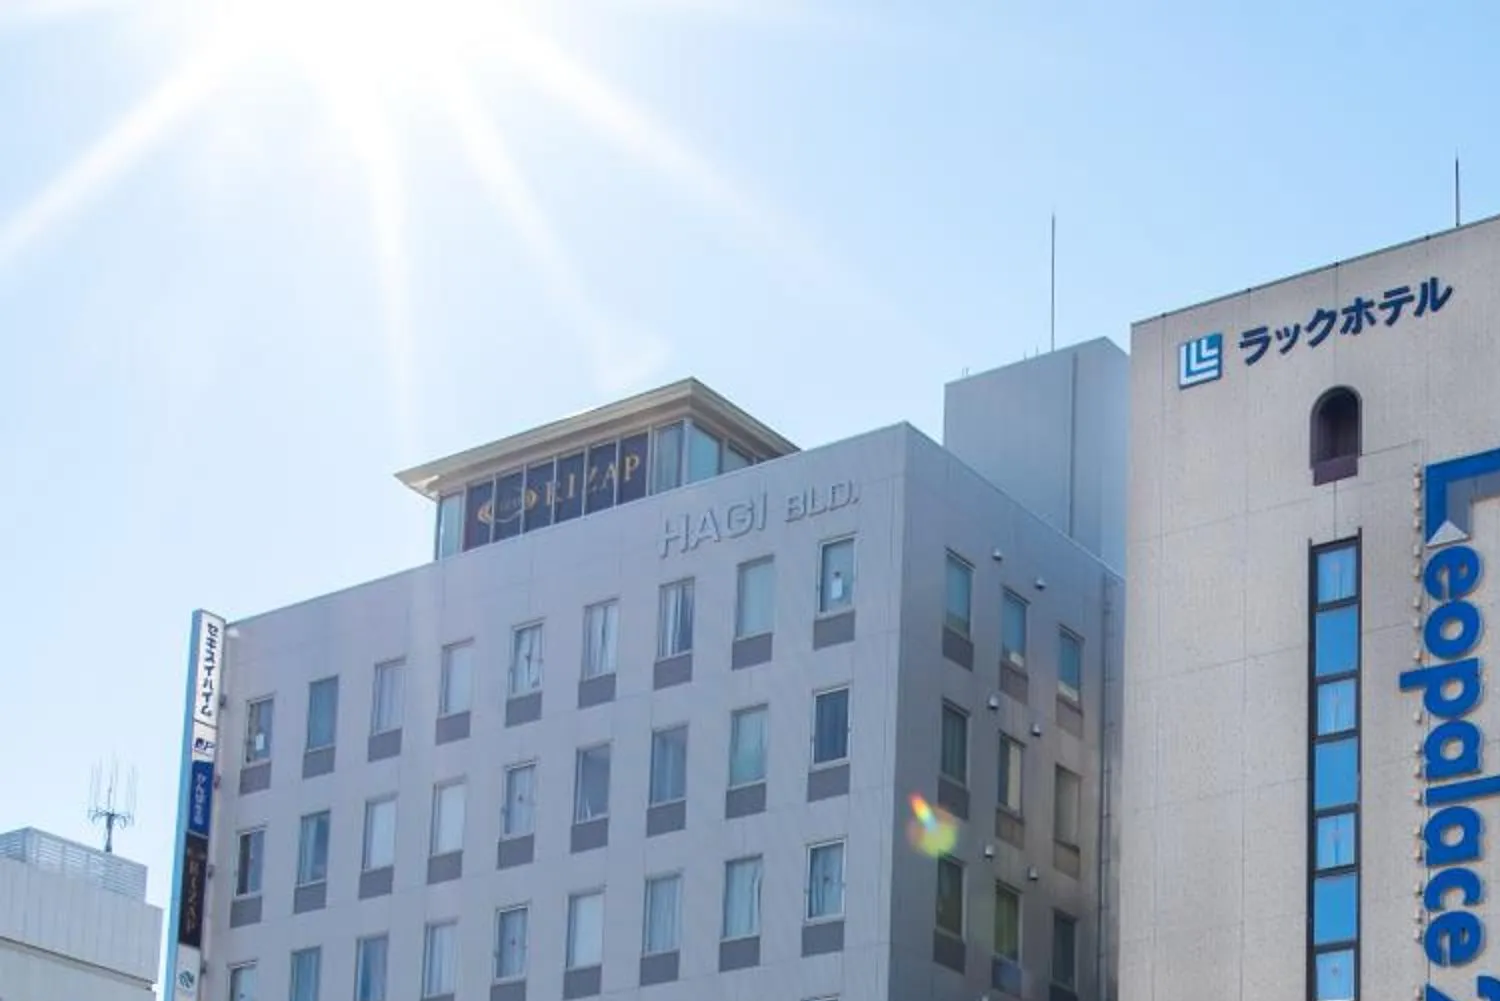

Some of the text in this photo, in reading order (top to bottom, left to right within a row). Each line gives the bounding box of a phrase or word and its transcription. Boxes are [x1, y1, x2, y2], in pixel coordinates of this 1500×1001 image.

[1239, 277, 1453, 365] ラックホテル
[660, 491, 767, 559] HAGI
